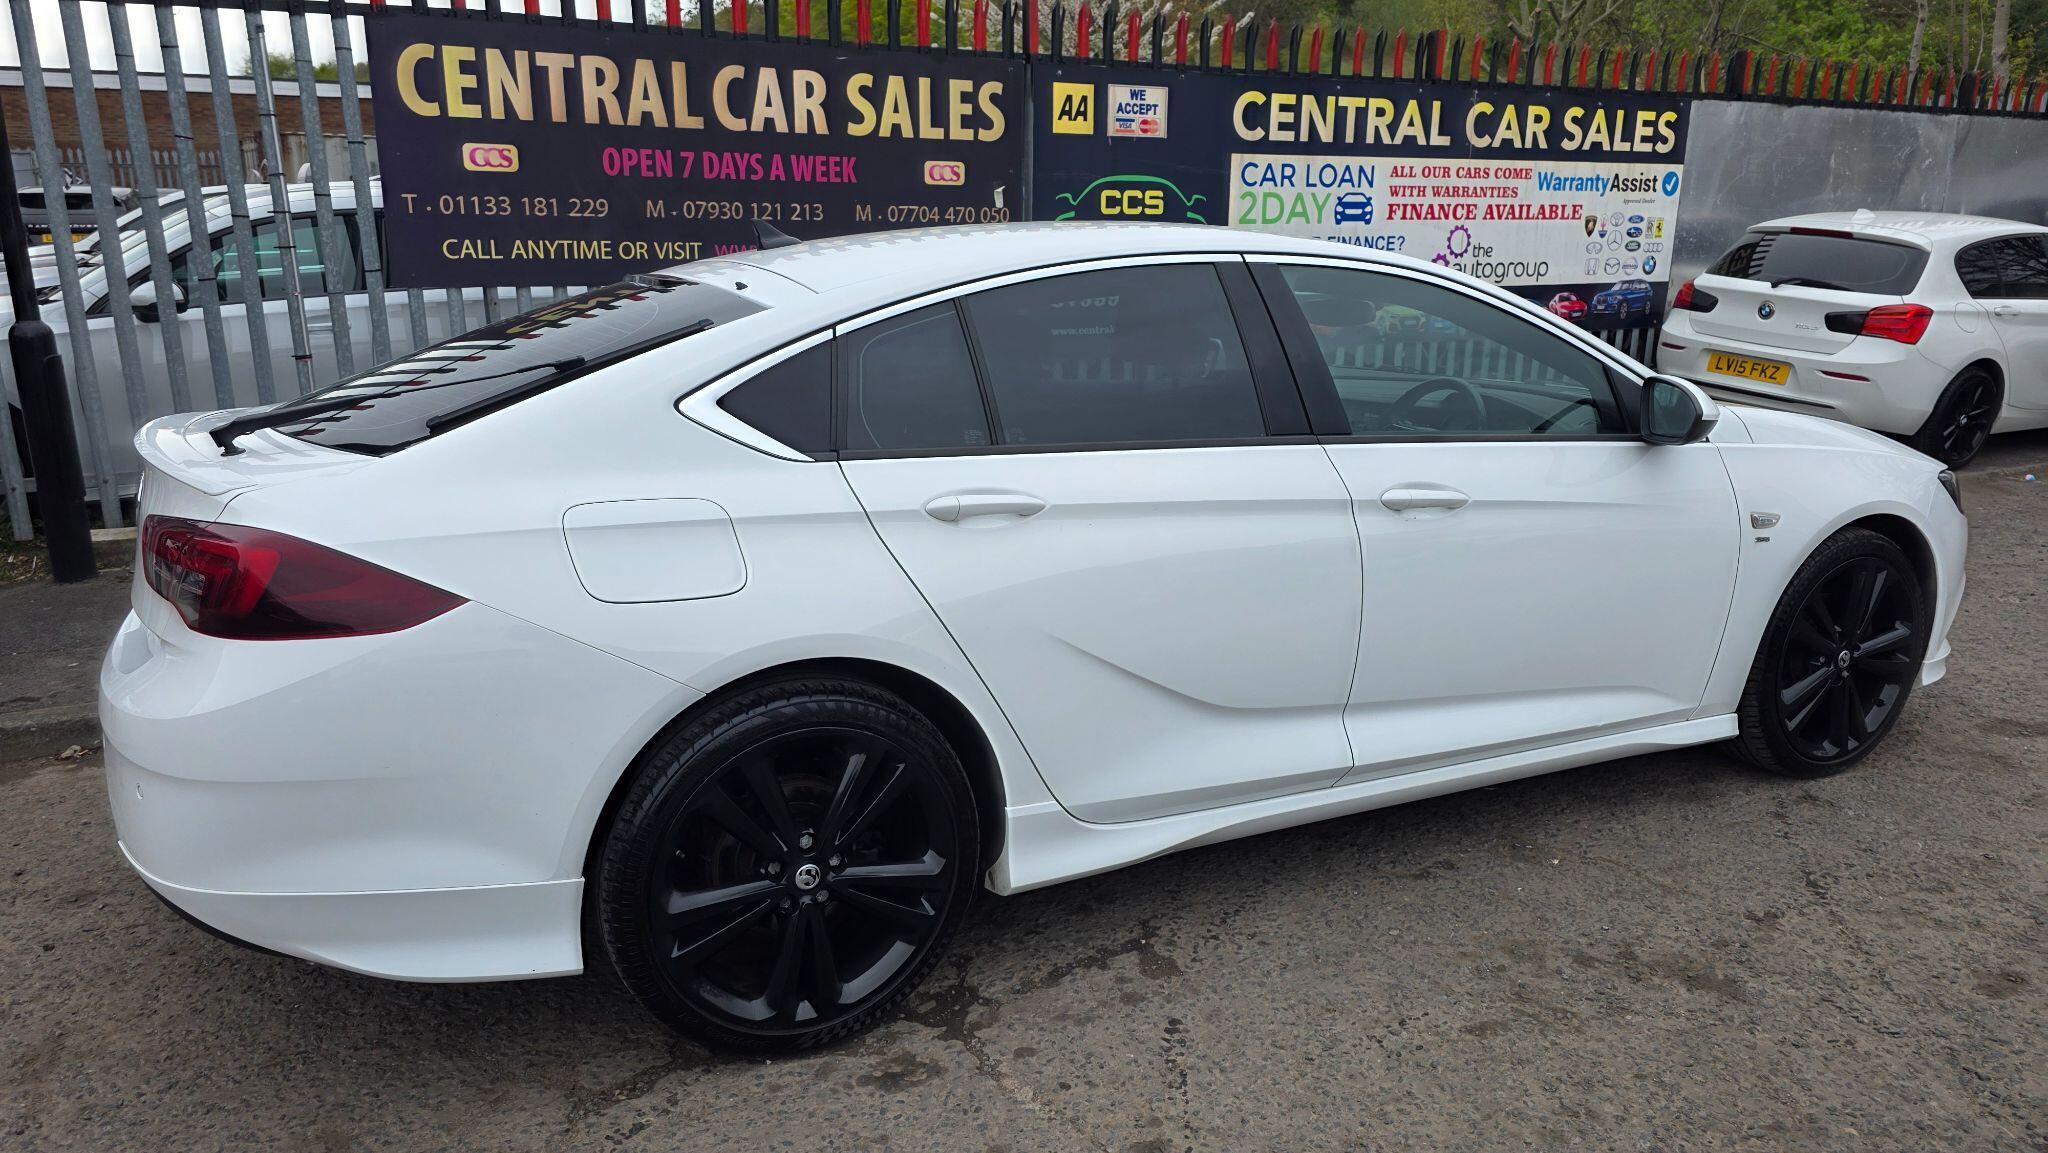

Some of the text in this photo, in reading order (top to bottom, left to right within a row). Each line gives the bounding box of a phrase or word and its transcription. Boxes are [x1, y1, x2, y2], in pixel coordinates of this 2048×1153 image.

[396, 43, 1006, 142] CENTRAL CAR SALES
[1129, 89, 1147, 101] WE
[1058, 94, 1089, 122] AA
[1116, 102, 1159, 115] ACCEPT
[1232, 90, 1679, 154] CENTRAL CAR SALES
[602, 147, 858, 183] OPEN 7 DAYS A WEEK
[1240, 161, 1376, 189] CAR LOAN
[1389, 165, 1533, 180] ALL OUR CARS COME
[1100, 189, 1164, 215] CCS
[1388, 185, 1519, 199] WITH WARRANTIES
[439, 195, 512, 216] 01133
[521, 197, 559, 216] 181
[568, 198, 609, 217] 229
[683, 201, 744, 220] 07930
[751, 202, 781, 220] 121
[790, 203, 824, 221] 213
[887, 205, 940, 222] 07704
[944, 206, 976, 223] 470
[980, 207, 1010, 224] 050
[1238, 191, 1333, 225] 2DAY
[1386, 203, 1584, 221] FINANCE AVAILABLE
[442, 238, 504, 259] CALL
[511, 240, 613, 260] ANYTIME
[618, 241, 649, 260] OR
[653, 242, 703, 260] VISIT
[1472, 242, 1493, 258] the
[1714, 355, 1781, 380] LV15 FKZ
